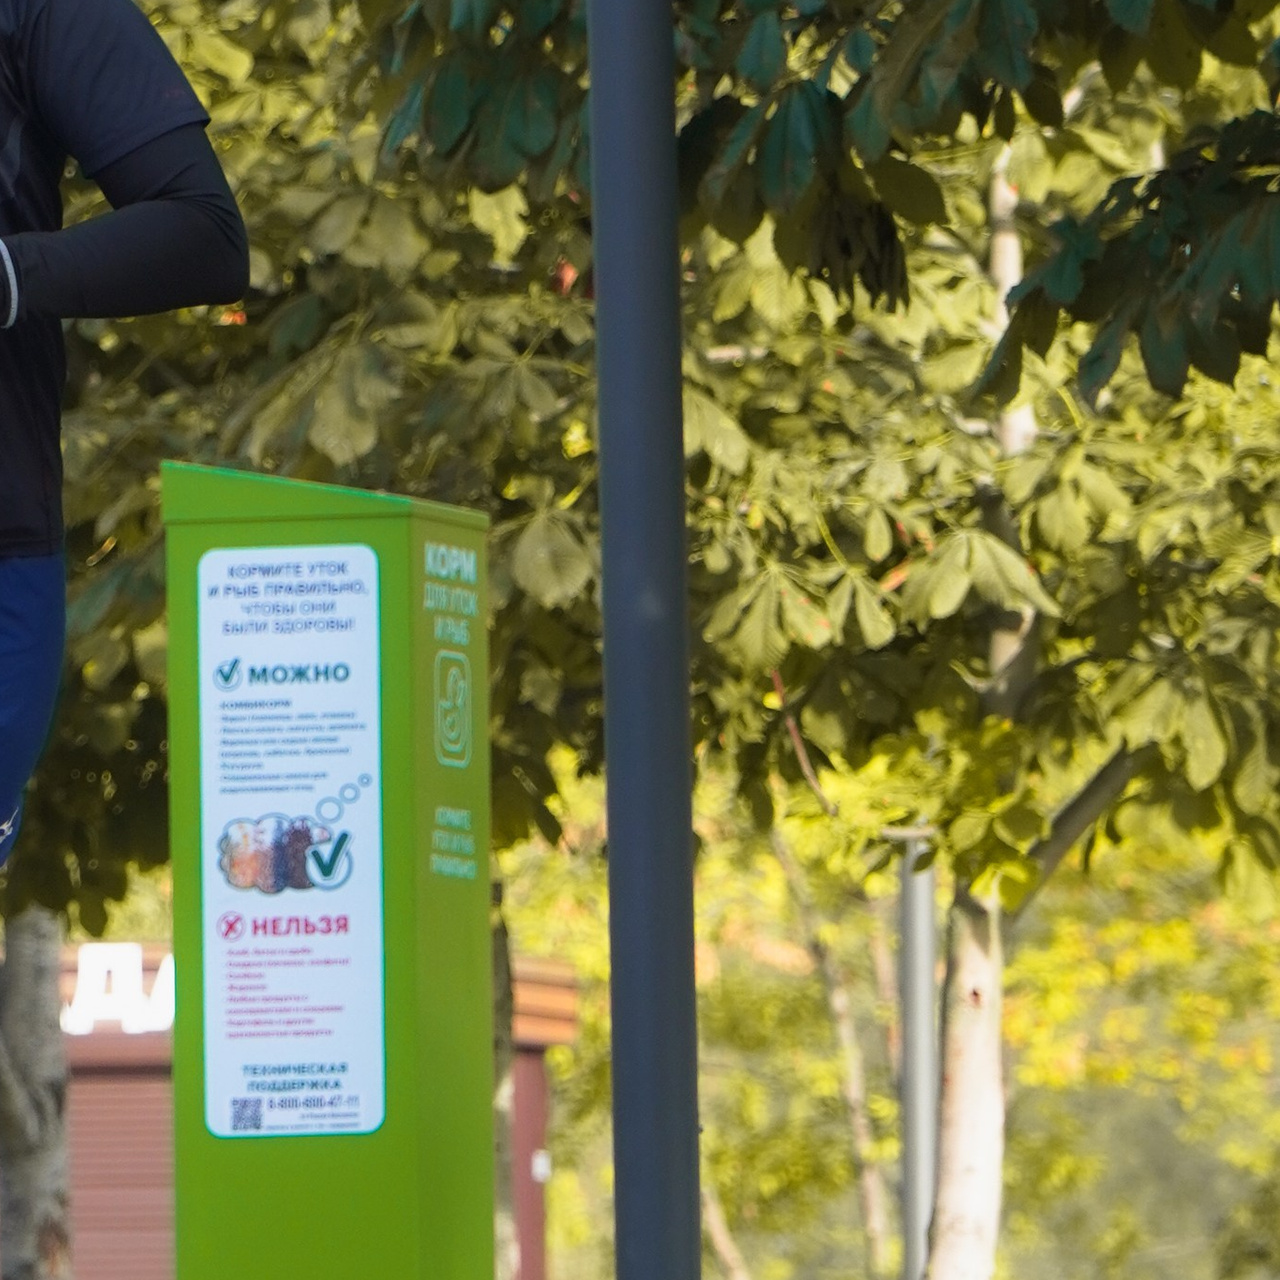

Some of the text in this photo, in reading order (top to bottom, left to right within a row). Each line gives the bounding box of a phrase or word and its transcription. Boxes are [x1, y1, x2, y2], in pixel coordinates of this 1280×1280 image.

[228, 561, 348, 578] КОРМИТЕ УТОК
[425, 541, 476, 584] КОРМ
[248, 663, 349, 685] МОЖНО
[252, 914, 349, 936] НЕЛЬЗЯ
[242, 1062, 348, 1076] ТЕХНИЧЕСКАЯ
[247, 1079, 342, 1092] ПОДДЕРЖКА
